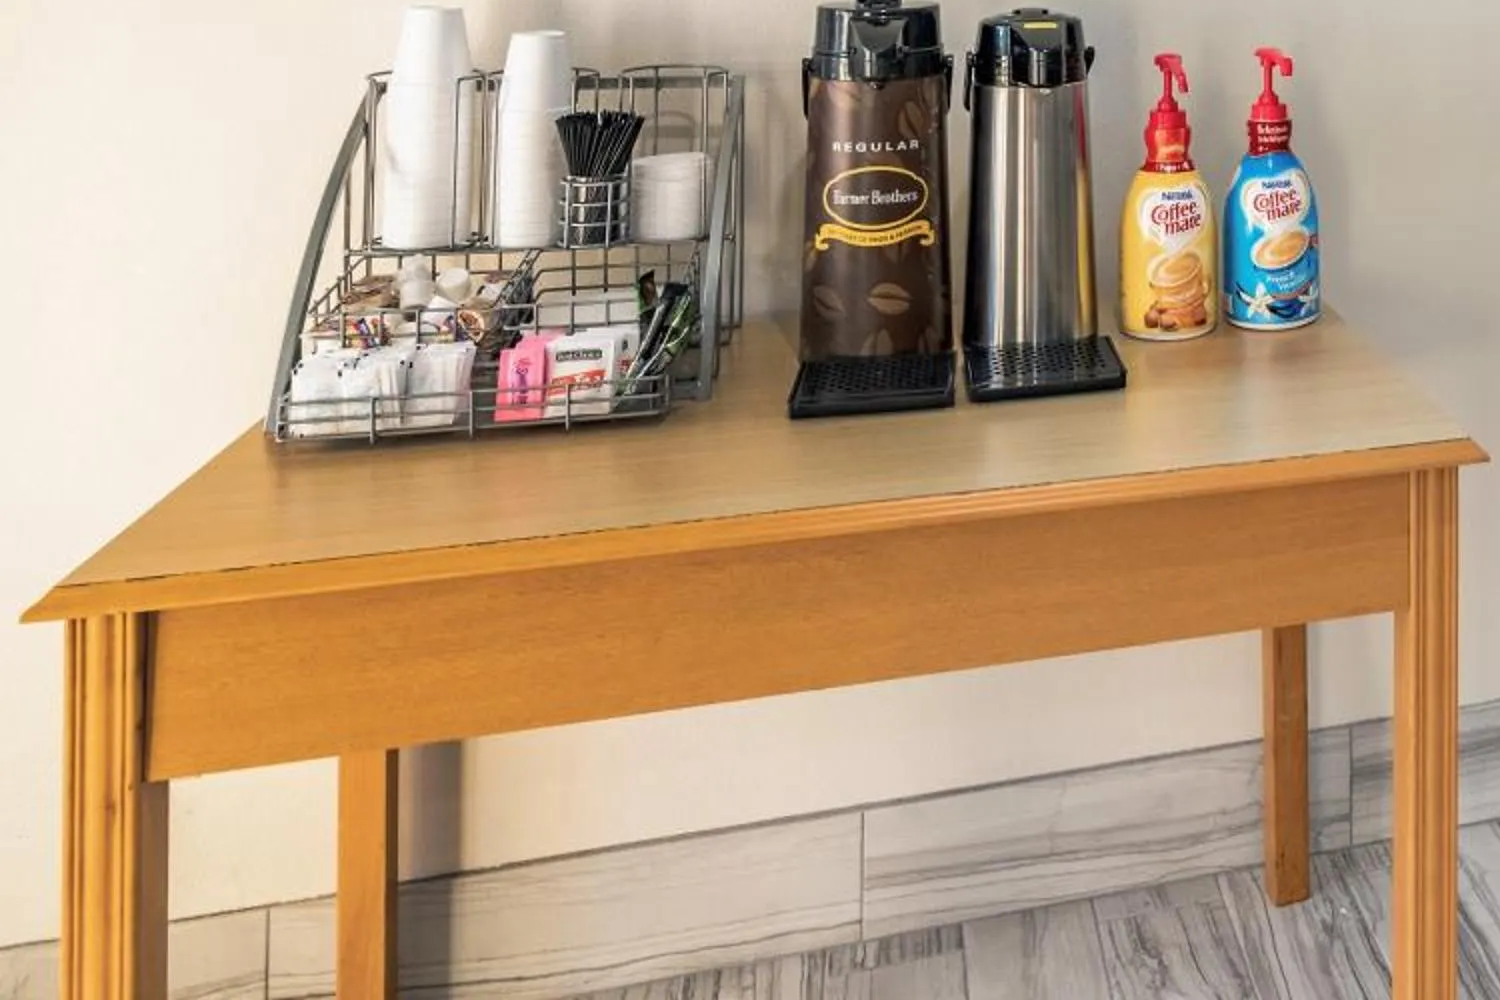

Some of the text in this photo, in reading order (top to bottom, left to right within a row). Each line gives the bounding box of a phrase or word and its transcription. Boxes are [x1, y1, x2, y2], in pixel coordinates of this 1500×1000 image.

[832, 139, 920, 153] REGULAR
[871, 188, 918, 205] Brothers
[1253, 189, 1297, 213] Coffee
[1151, 202, 1197, 226] Coffee
[1267, 199, 1301, 222] mate
[1164, 213, 1201, 235] mate
